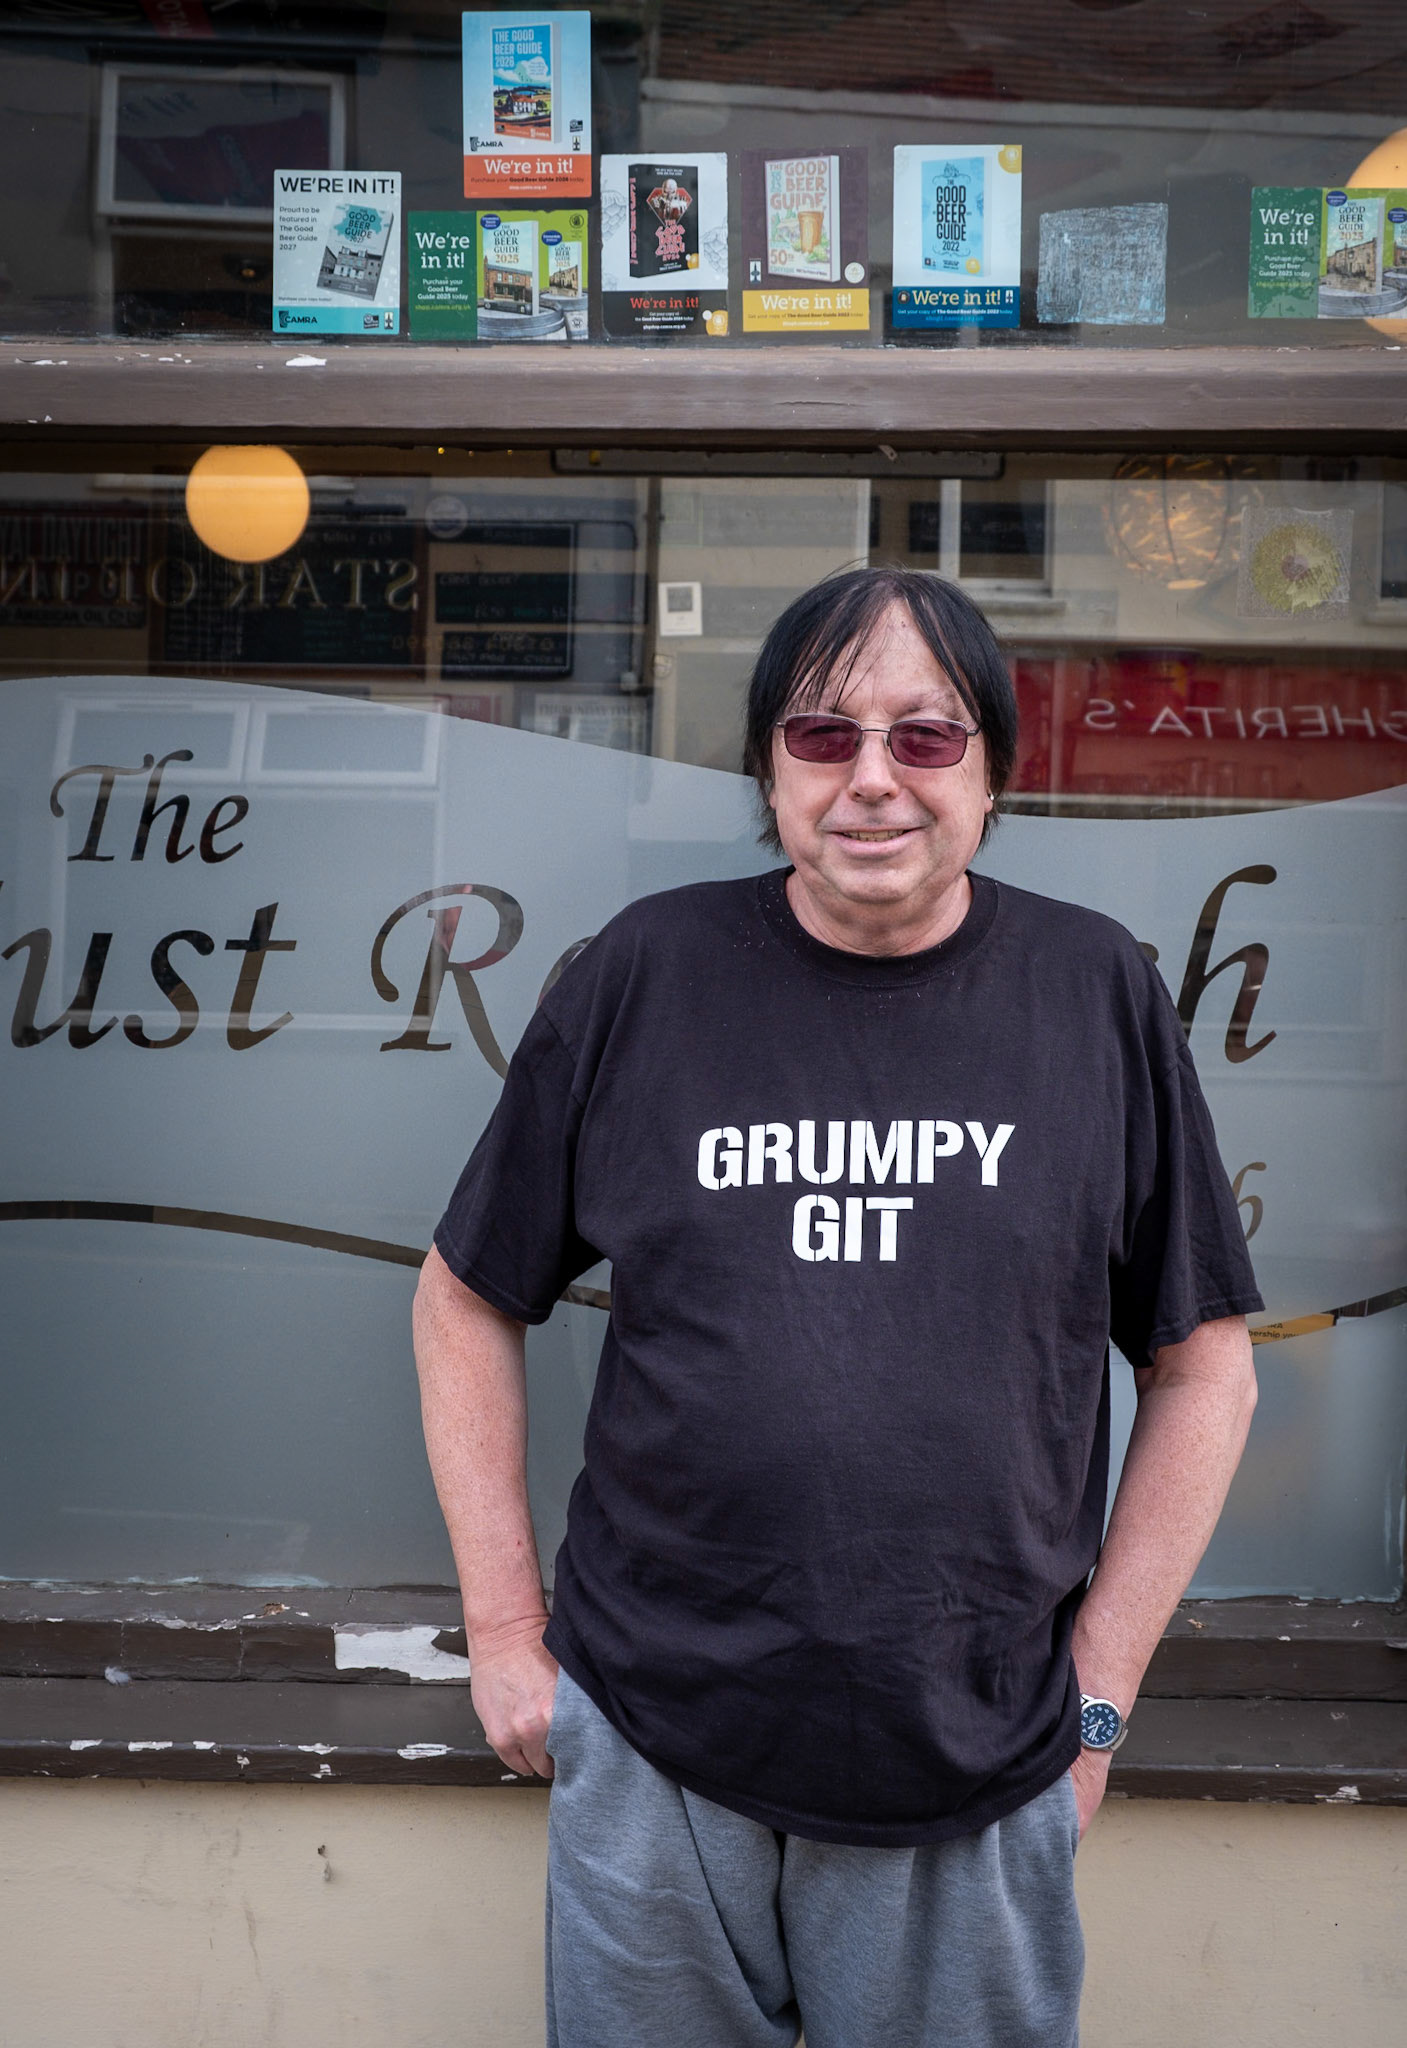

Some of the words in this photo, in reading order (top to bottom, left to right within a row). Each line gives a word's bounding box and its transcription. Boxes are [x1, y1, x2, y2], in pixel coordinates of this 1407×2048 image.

[494, 31, 509, 42] THE
[512, 29, 534, 42] GOOD
[494, 43, 514, 55] BEER
[517, 42, 542, 54] GUIDE
[475, 140, 503, 148] CAMRA
[484, 158, 531, 174] We're
[536, 157, 553, 174] in
[557, 157, 573, 174] it!
[785, 160, 828, 176] GOOD
[280, 177, 344, 193] WE'RE
[348, 178, 366, 193] IN
[372, 178, 394, 194] IT!
[786, 176, 827, 192] BEER
[936, 185, 966, 204] GOOD
[348, 211, 376, 222] GOOD
[936, 204, 966, 224] BEER
[1259, 208, 1314, 226] We're
[1338, 206, 1366, 214] GOOD
[1339, 214, 1364, 222] BEER
[348, 220, 371, 230] BEER
[936, 224, 967, 241] GUIDE
[344, 228, 372, 239] GUIDE
[415, 232, 470, 249] We're
[494, 237, 518, 246] BEER
[1263, 229, 1284, 245] in
[1290, 228, 1308, 245] it!
[494, 246, 519, 254] GUIDE
[942, 241, 960, 252] 2022
[420, 252, 442, 268] in
[446, 252, 464, 268] it!
[770, 250, 788, 266] 50
[630, 298, 666, 309] We're
[669, 297, 683, 308] in
[686, 296, 699, 308] it!
[761, 294, 810, 310] We're
[814, 294, 832, 310] in
[836, 293, 852, 309] it!
[912, 290, 960, 306] We're
[964, 290, 982, 306] in
[985, 289, 1001, 306] it!
[284, 316, 318, 324] CAMRA
[50, 749, 249, 864] The
[0, 900, 297, 1051] ust
[697, 1119, 1015, 1191] GRUMPY
[792, 1194, 913, 1262] GIT
